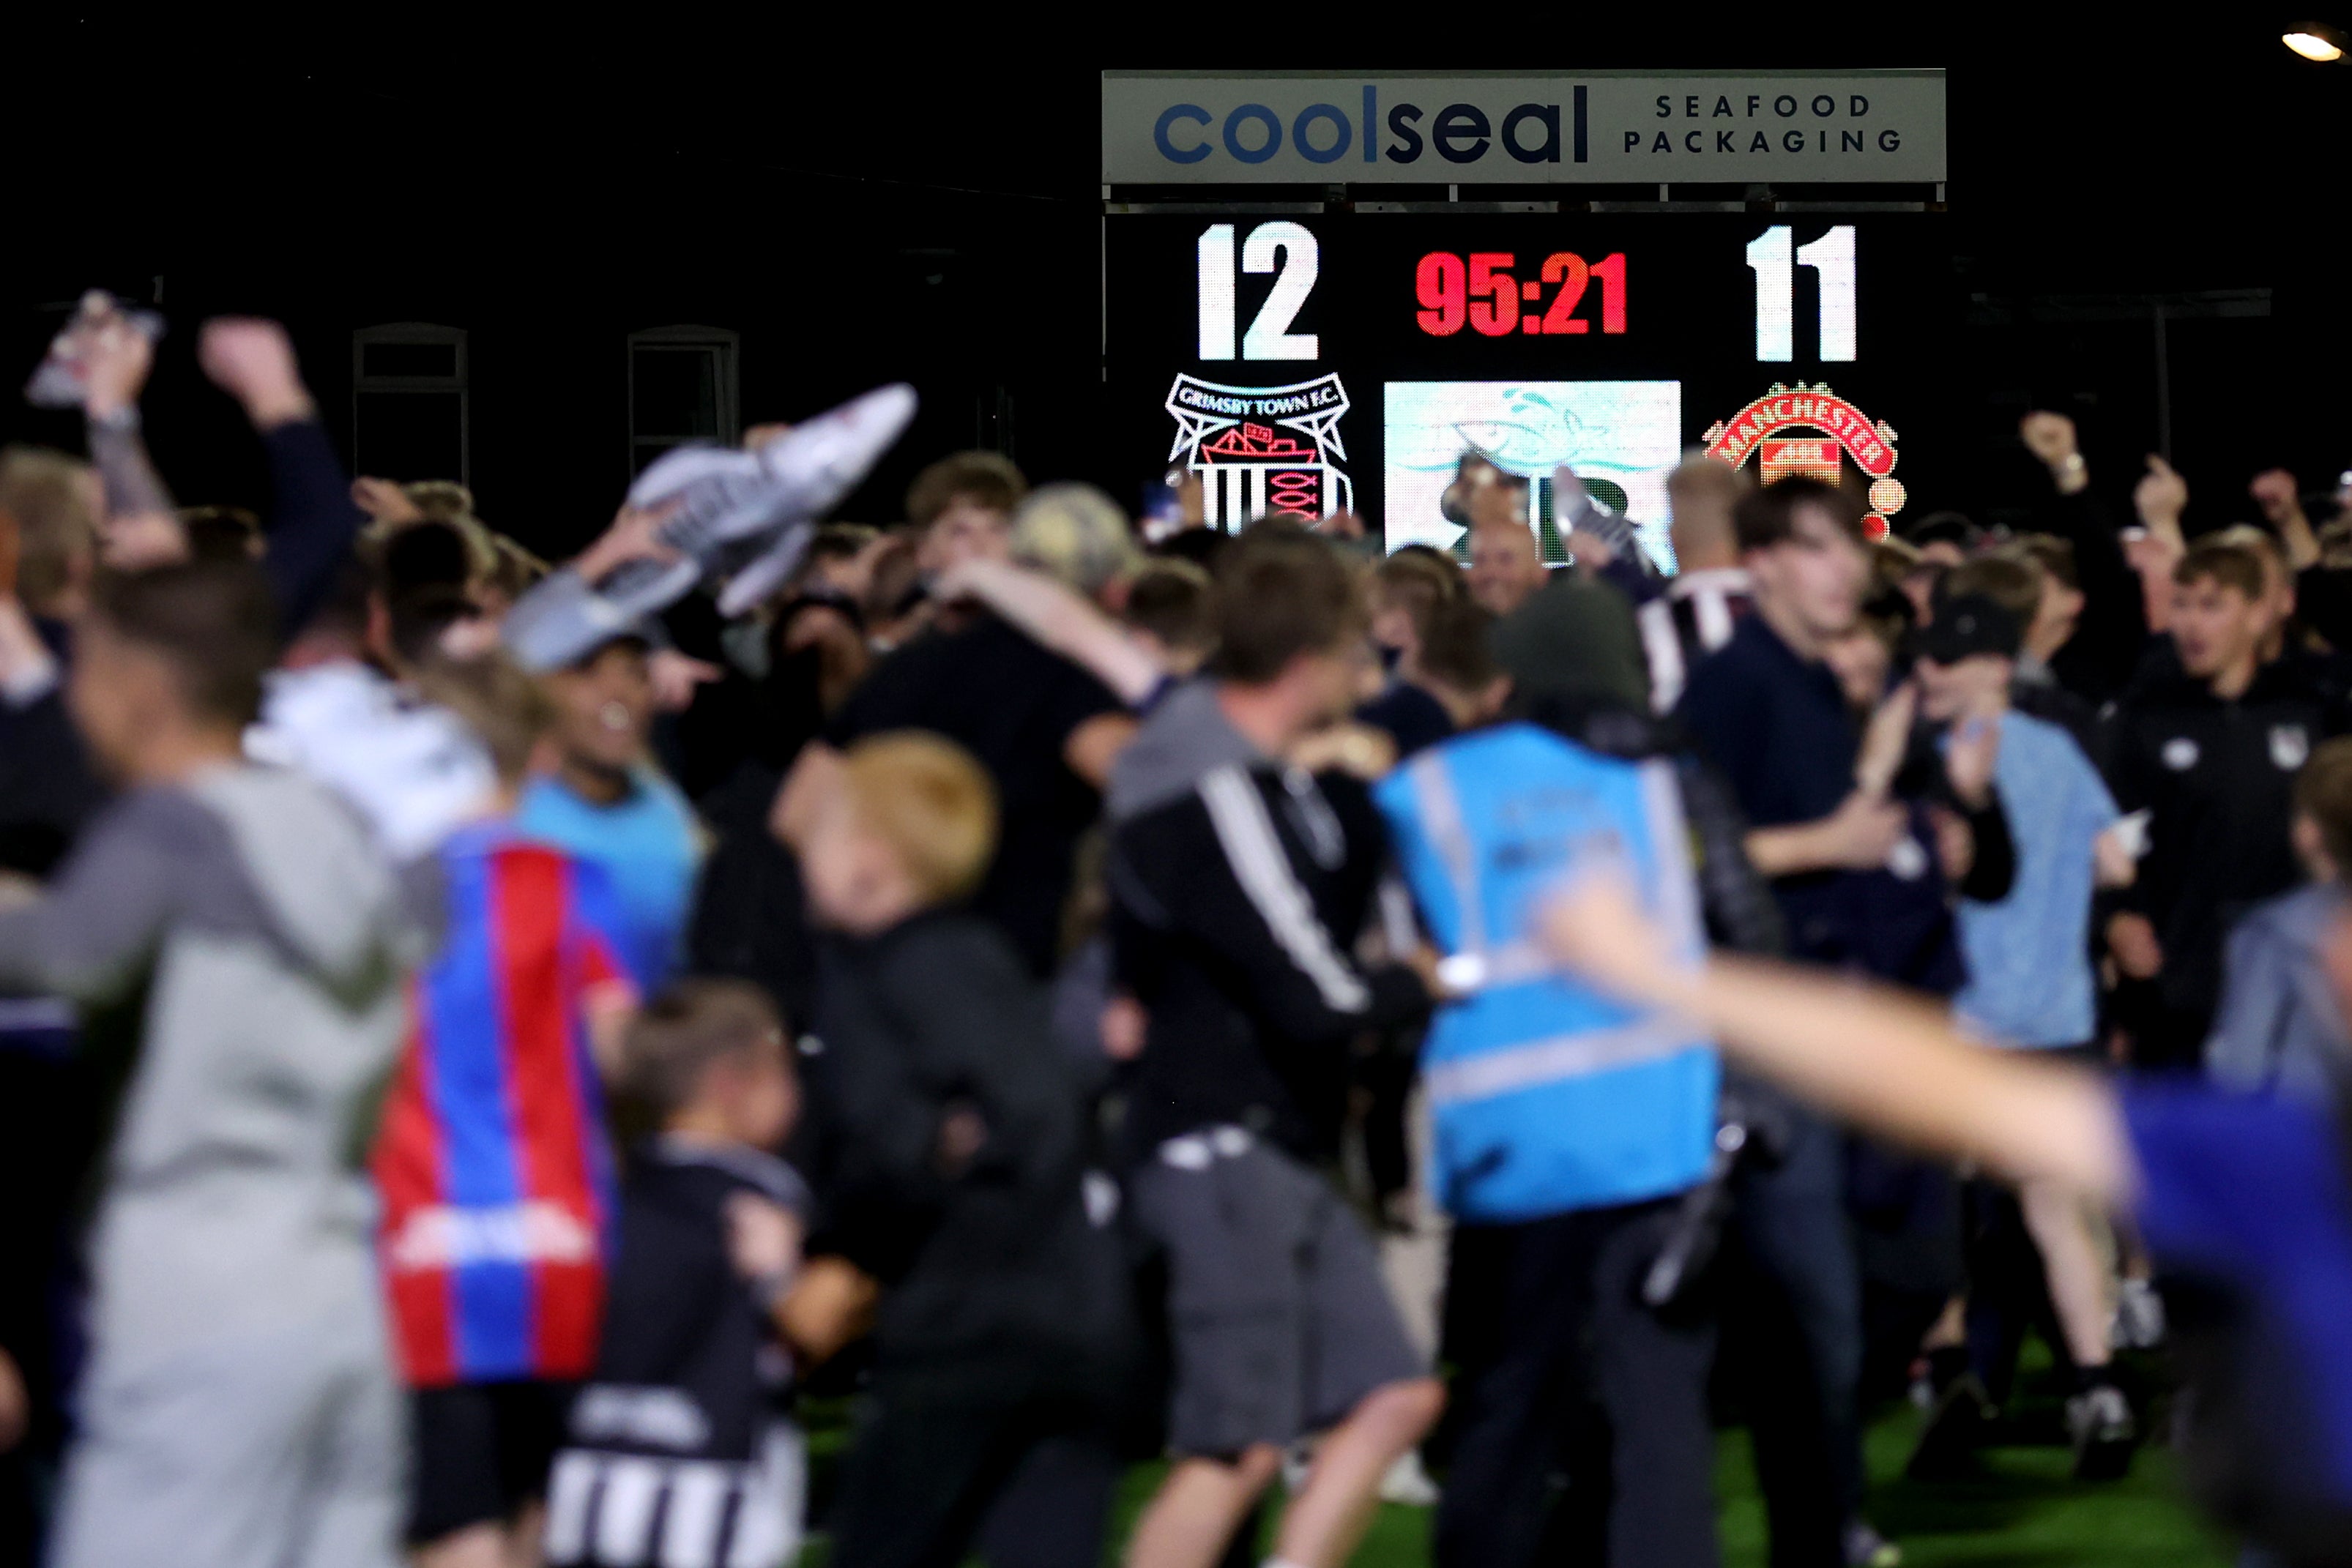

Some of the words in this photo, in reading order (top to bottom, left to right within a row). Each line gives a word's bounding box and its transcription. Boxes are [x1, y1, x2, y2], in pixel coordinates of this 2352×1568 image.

[1153, 84, 1588, 165] coolseal
[1623, 128, 1902, 154] PACKAGING
[1655, 93, 1871, 119] SEAFOOD
[1197, 221, 1319, 361] 12
[1415, 252, 1627, 337] 95:21
[1746, 225, 1857, 362] 11
[1179, 387, 1252, 416] GRIMSBY
[1254, 395, 1309, 416] TOWN
[1719, 397, 1884, 464] MANCHESTER
